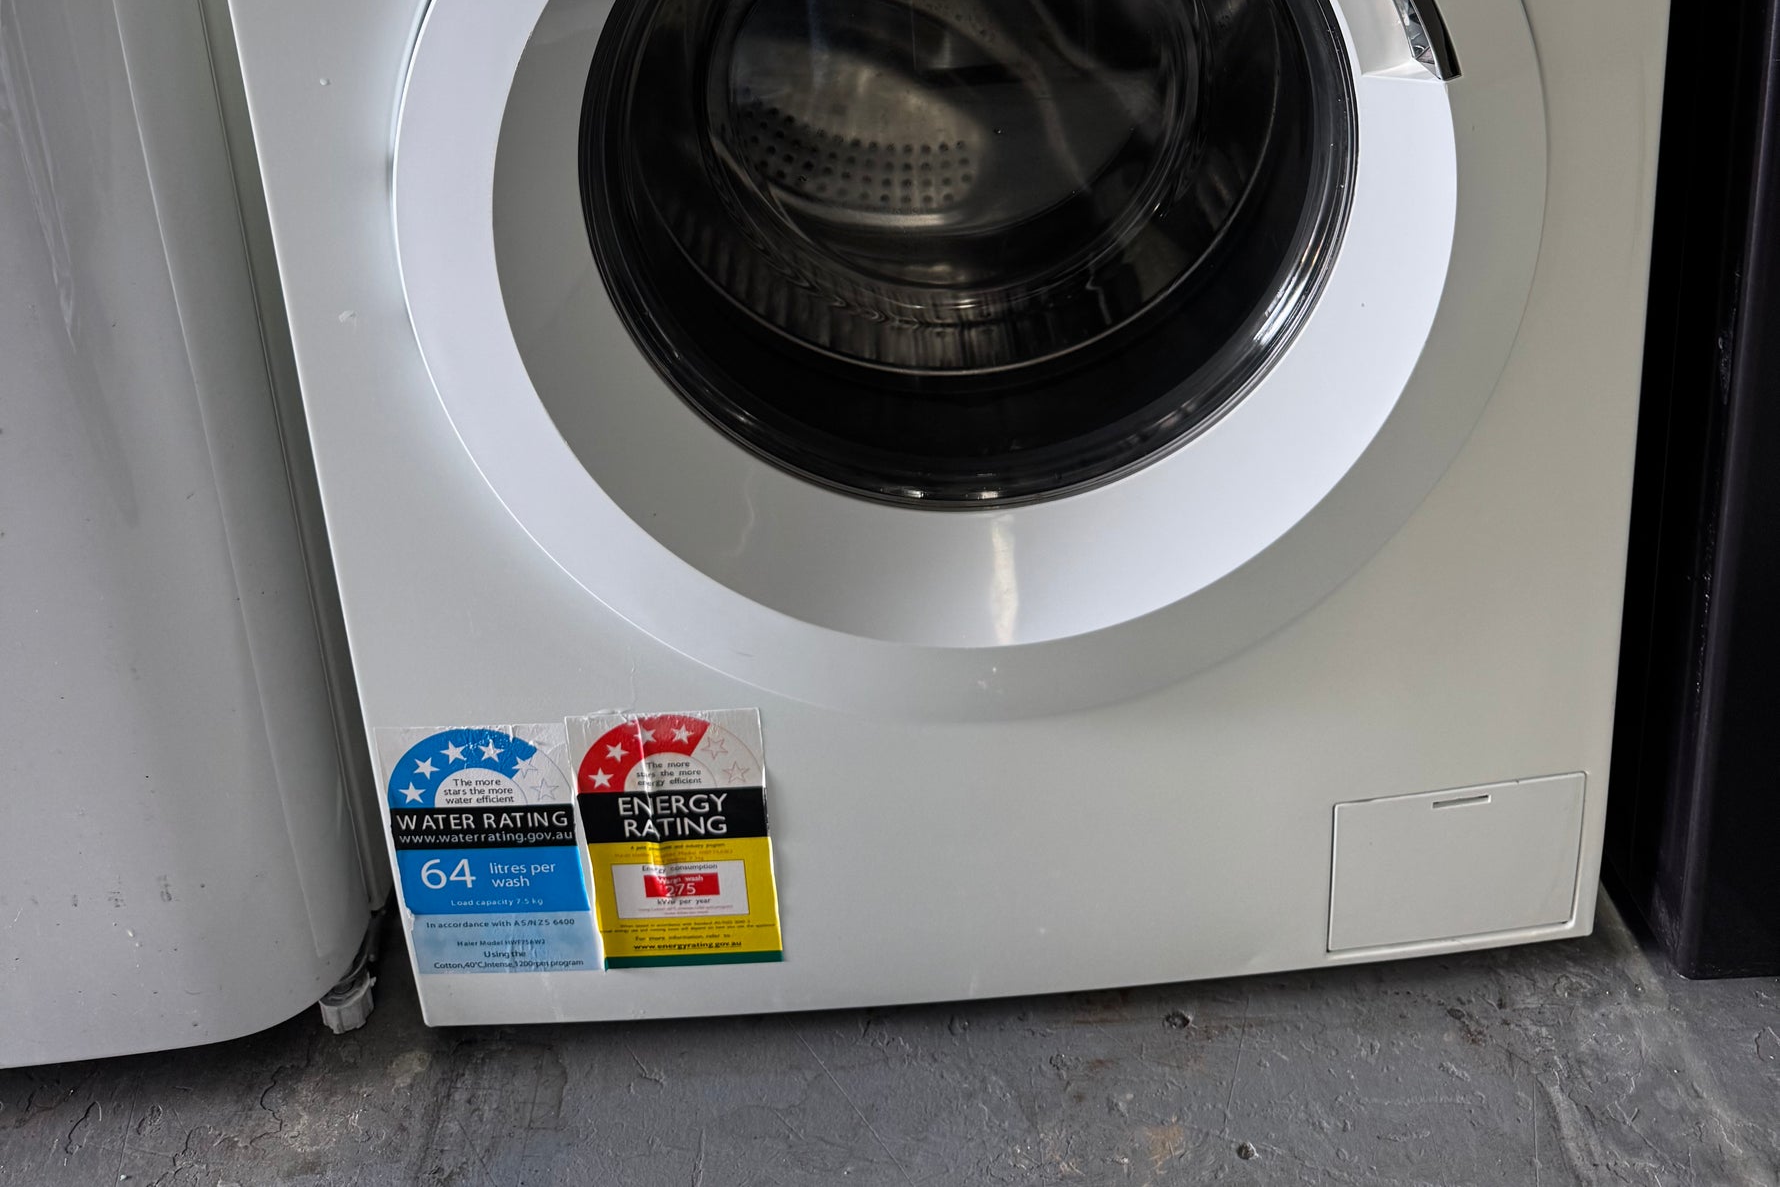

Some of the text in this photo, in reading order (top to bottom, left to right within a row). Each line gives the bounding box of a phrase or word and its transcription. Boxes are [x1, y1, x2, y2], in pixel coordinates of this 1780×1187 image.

[453, 778, 501, 786] The more
[669, 777, 702, 785] efficient
[469, 787, 485, 795] the
[488, 787, 513, 795] more
[446, 794, 515, 804] water efficient
[618, 793, 728, 816] ENERGY
[396, 811, 568, 830] WATER RATING
[623, 815, 728, 841] RATING
[399, 831, 573, 844] www.waterrating.gov.au
[489, 862, 556, 876] litres per
[671, 864, 718, 872] consumption
[420, 858, 476, 890] 64
[491, 876, 530, 888] wash
[665, 882, 697, 897] 275
[475, 898, 514, 908] capacity
[531, 898, 544, 906] kg
[426, 921, 436, 929] In
[437, 921, 489, 929] accordance
[513, 919, 550, 927] AS/NZS
[552, 918, 575, 926] 6400
[633, 940, 742, 951] www.energyrating.gov.au
[483, 950, 510, 959] Using
[550, 958, 584, 968] program
